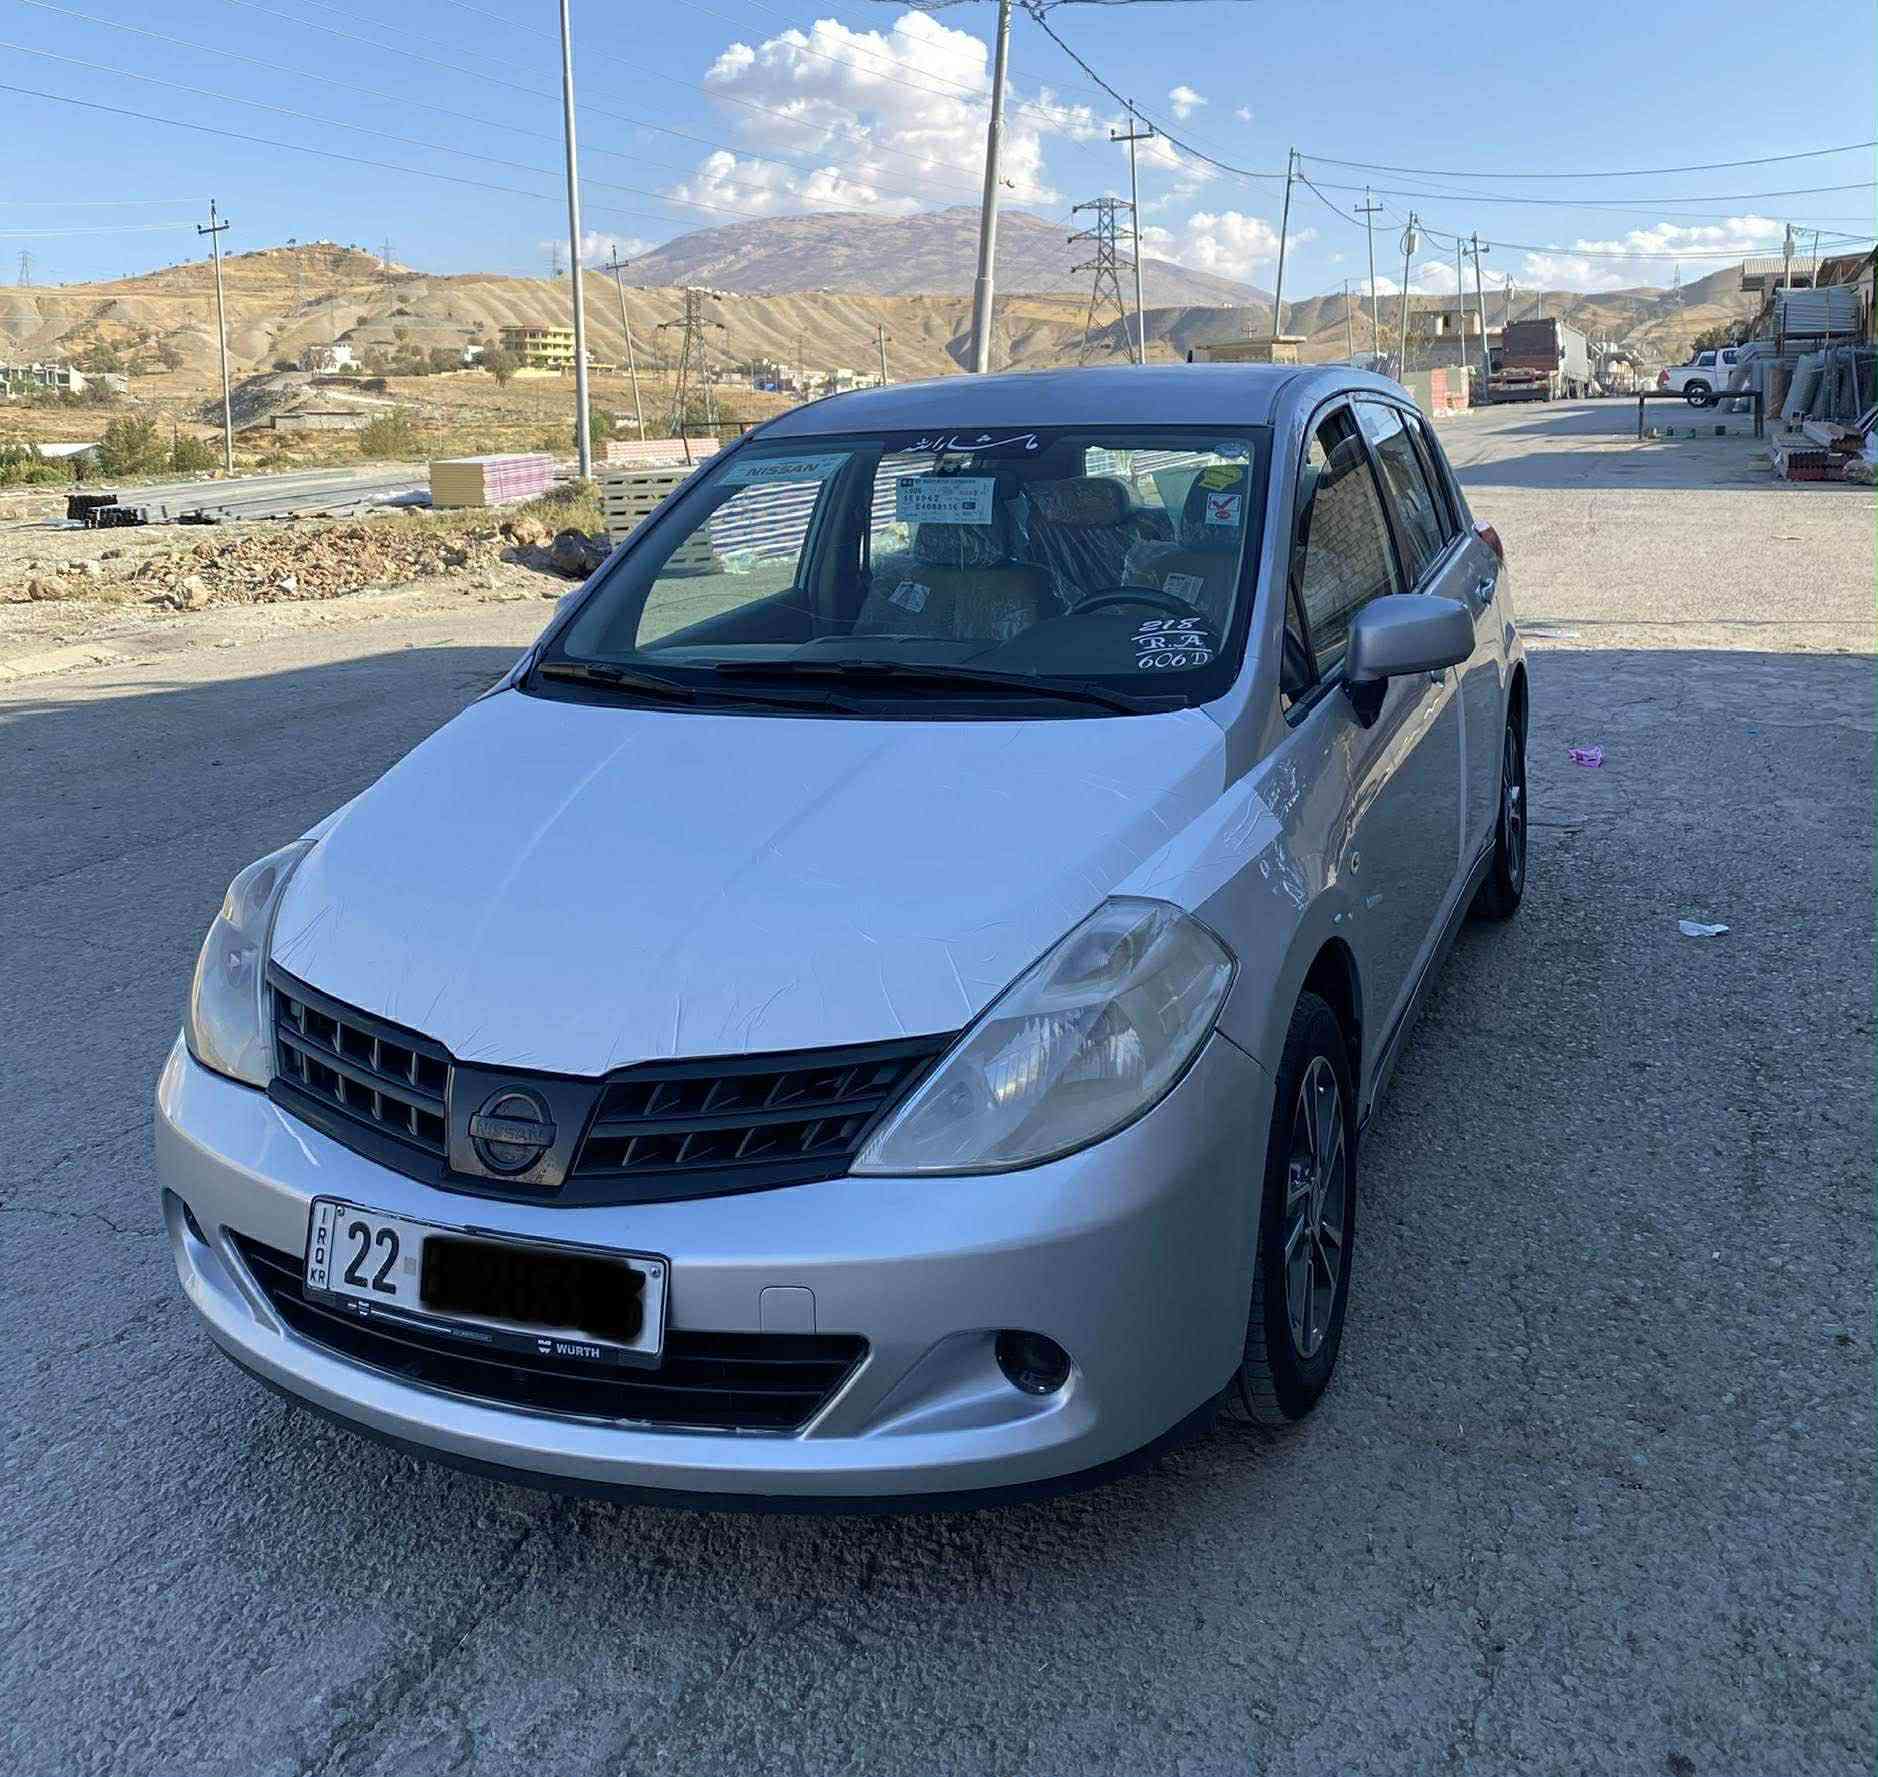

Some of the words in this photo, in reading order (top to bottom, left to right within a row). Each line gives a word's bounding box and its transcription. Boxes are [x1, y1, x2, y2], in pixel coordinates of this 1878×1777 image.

[746, 463, 820, 477] NISSAN
[479, 1121, 546, 1142] NISSAN
[343, 1220, 400, 1295] 22
